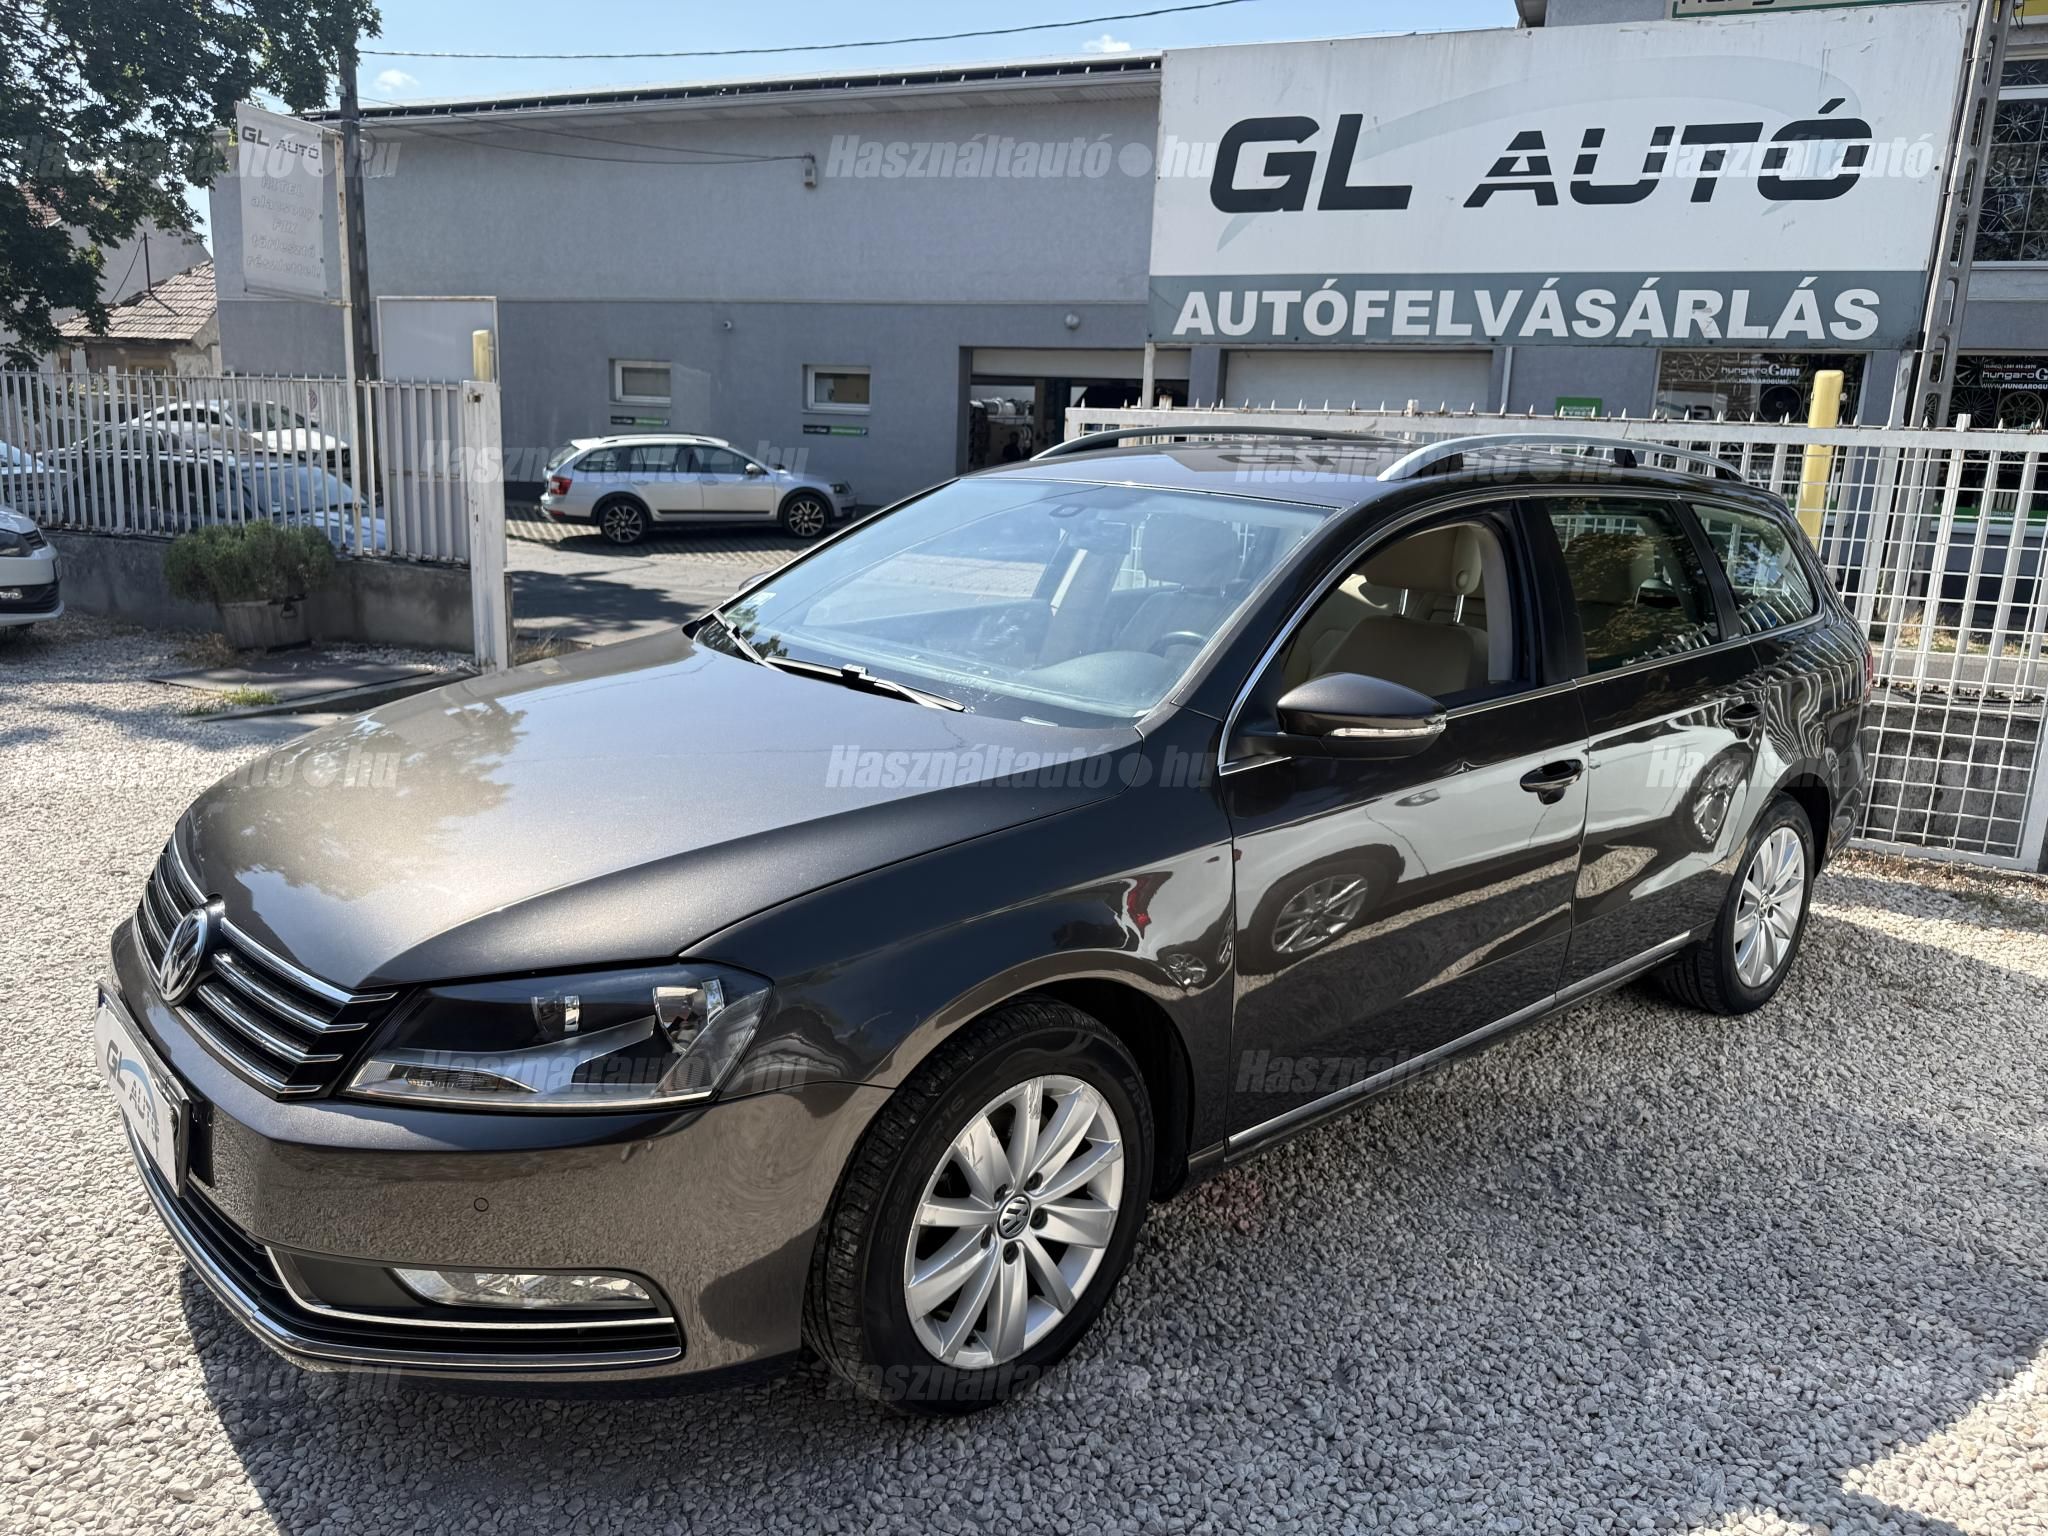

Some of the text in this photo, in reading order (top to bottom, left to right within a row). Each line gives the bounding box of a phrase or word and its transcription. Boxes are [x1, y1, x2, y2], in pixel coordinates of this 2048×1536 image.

[242, 126, 319, 160] GL AUTÓ
[1210, 98, 1872, 213] GL AUTÓ
[1172, 277, 1880, 341] AUTÓFELVÁSÁRLÁS
